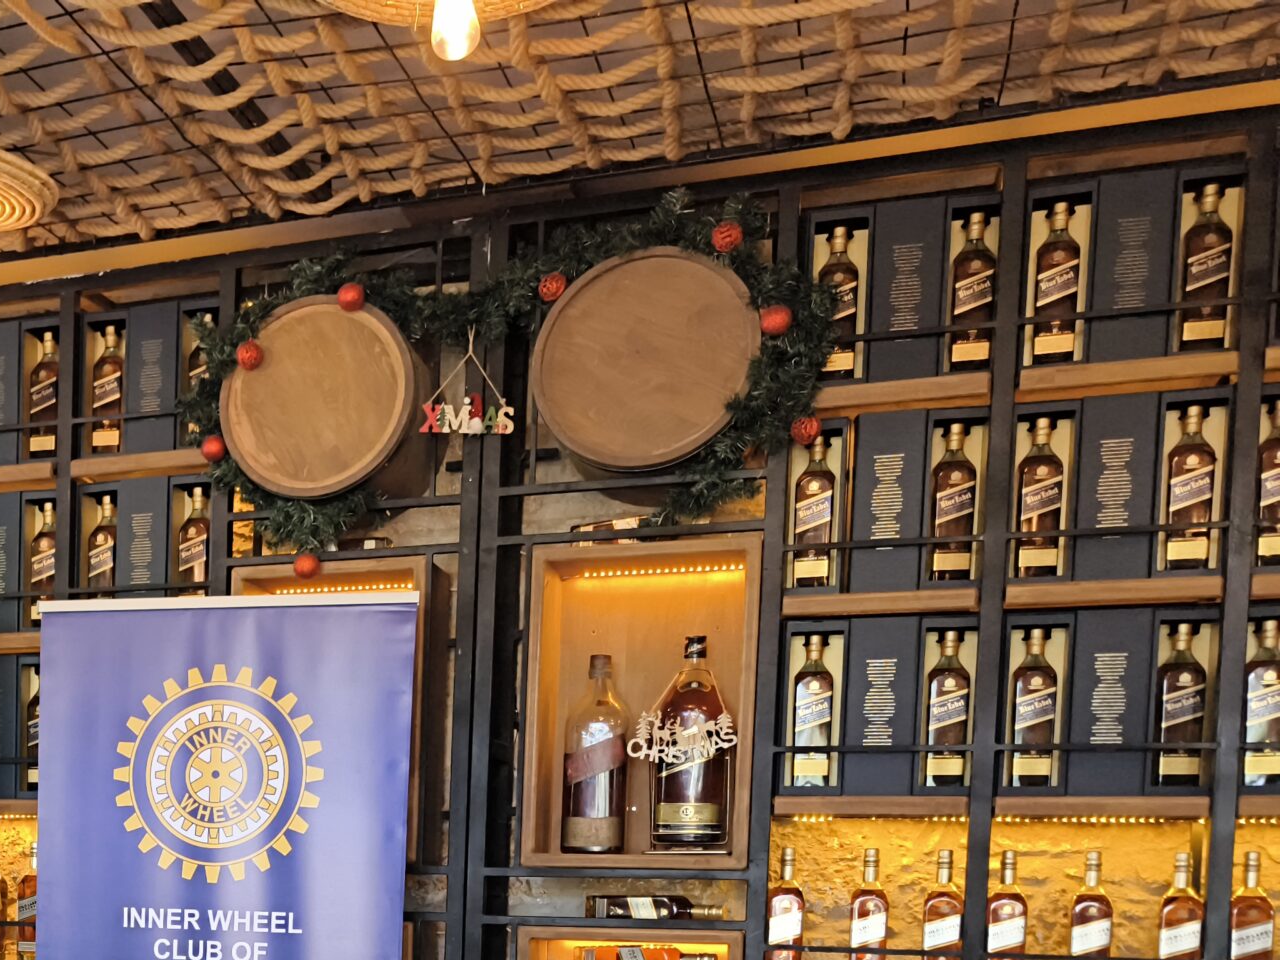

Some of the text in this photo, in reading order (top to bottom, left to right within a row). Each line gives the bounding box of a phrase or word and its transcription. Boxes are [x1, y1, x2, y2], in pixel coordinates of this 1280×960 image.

[419, 403, 514, 434] XMAS
[184, 726, 252, 755] INNER
[179, 792, 253, 823] WHEEL
[122, 906, 303, 934] INNER WHEEL
